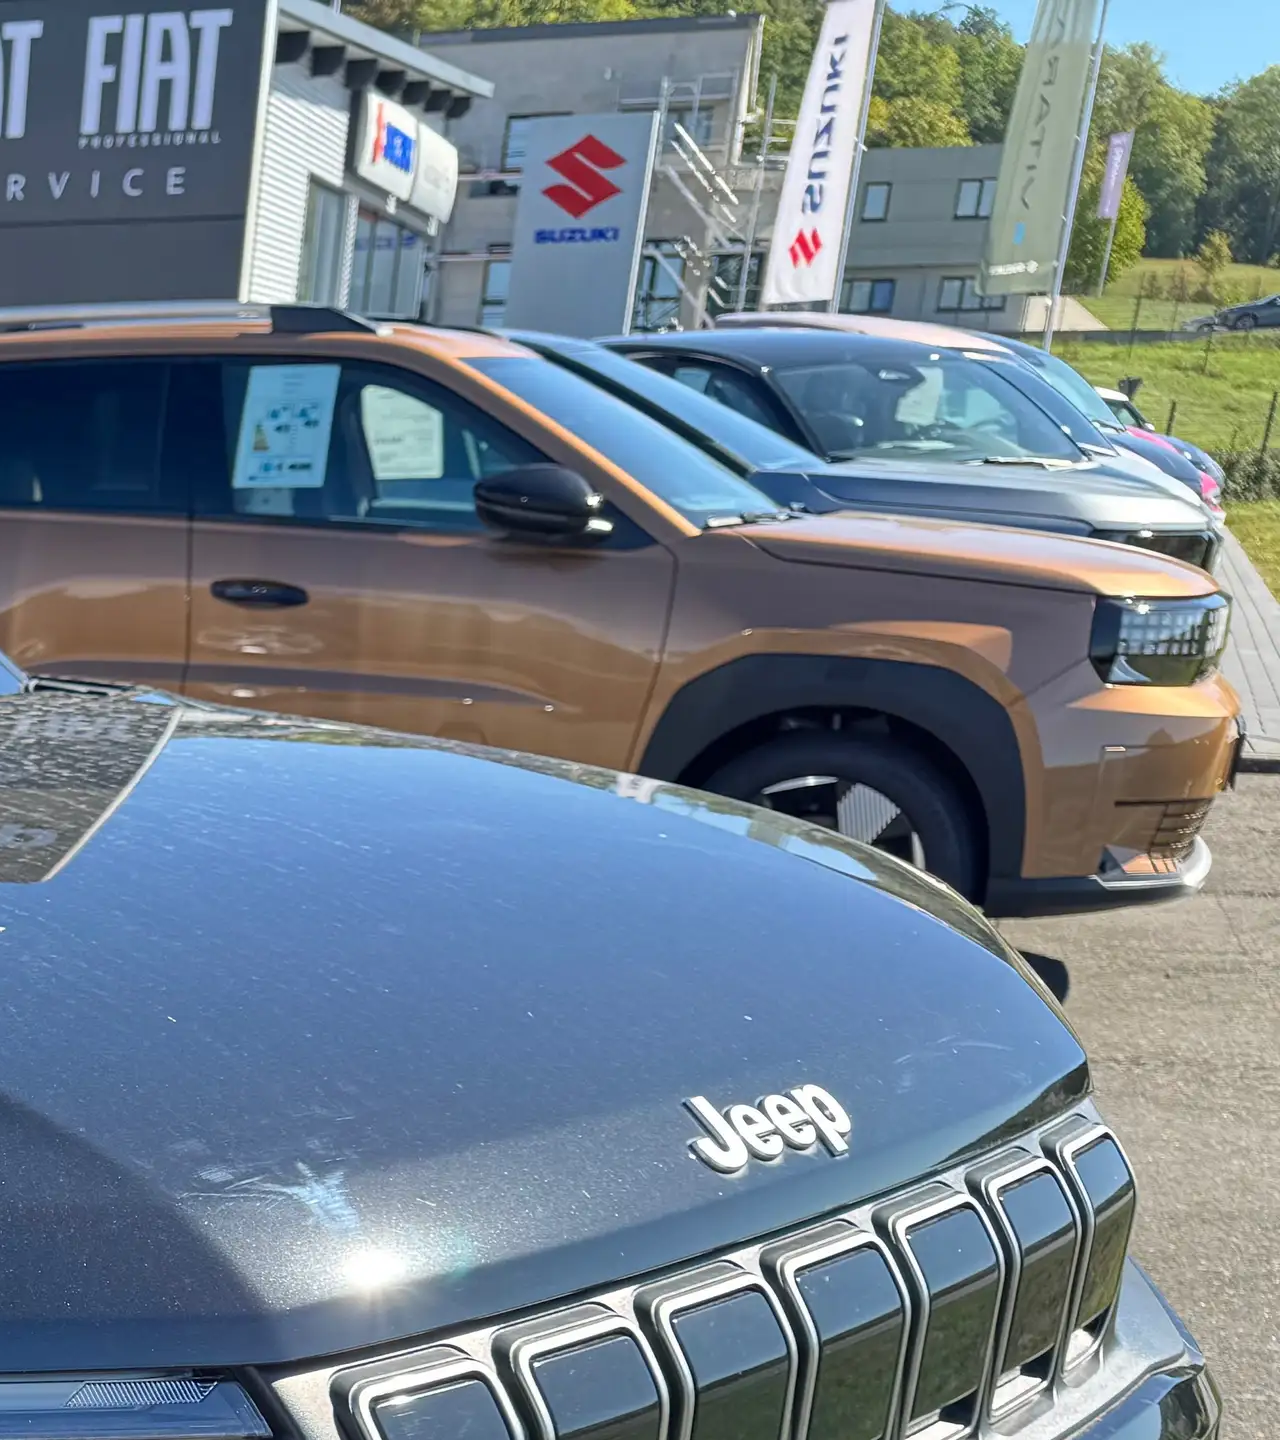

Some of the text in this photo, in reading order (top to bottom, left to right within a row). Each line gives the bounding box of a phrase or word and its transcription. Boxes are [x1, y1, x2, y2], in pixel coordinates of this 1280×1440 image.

[80, 8, 233, 135] FIAT
[78, 131, 221, 149] PROFESSIONAL
[534, 227, 620, 243] SUZUKI
[680, 1084, 852, 1174] Jeep
